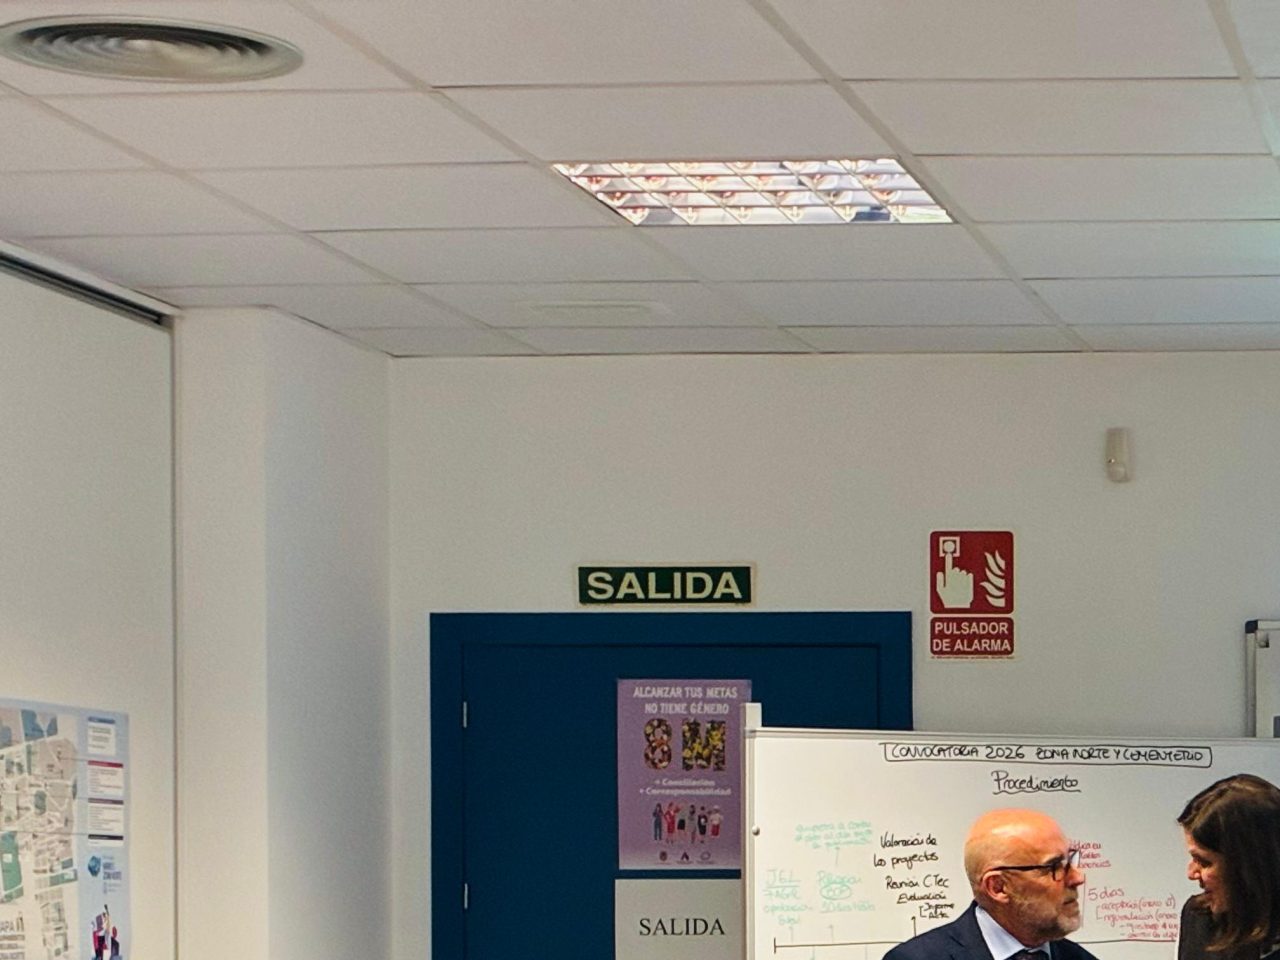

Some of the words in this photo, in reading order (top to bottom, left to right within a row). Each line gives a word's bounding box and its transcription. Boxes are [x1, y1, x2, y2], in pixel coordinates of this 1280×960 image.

[587, 571, 743, 600] SALIDA
[934, 622, 1009, 635] PULSADOR
[932, 639, 951, 652] DE
[953, 639, 1012, 652] ALARMA
[633, 686, 683, 699] ALCANZAR
[684, 686, 703, 699] TUS
[706, 686, 738, 699] METAS
[645, 702, 658, 715] NO
[661, 702, 687, 715] TIENE
[689, 699, 729, 715] GÉNERO
[891, 743, 979, 759] CONVOCATORIA
[985, 744, 1026, 760] 2026
[1036, 747, 1069, 760] ZONA
[1072, 747, 1112, 760] NORTE
[1112, 747, 1121, 760] Y
[1122, 747, 1204, 762] CEMENTERIO
[990, 769, 1079, 790] Procedimiento
[639, 917, 725, 936] SALIDA
